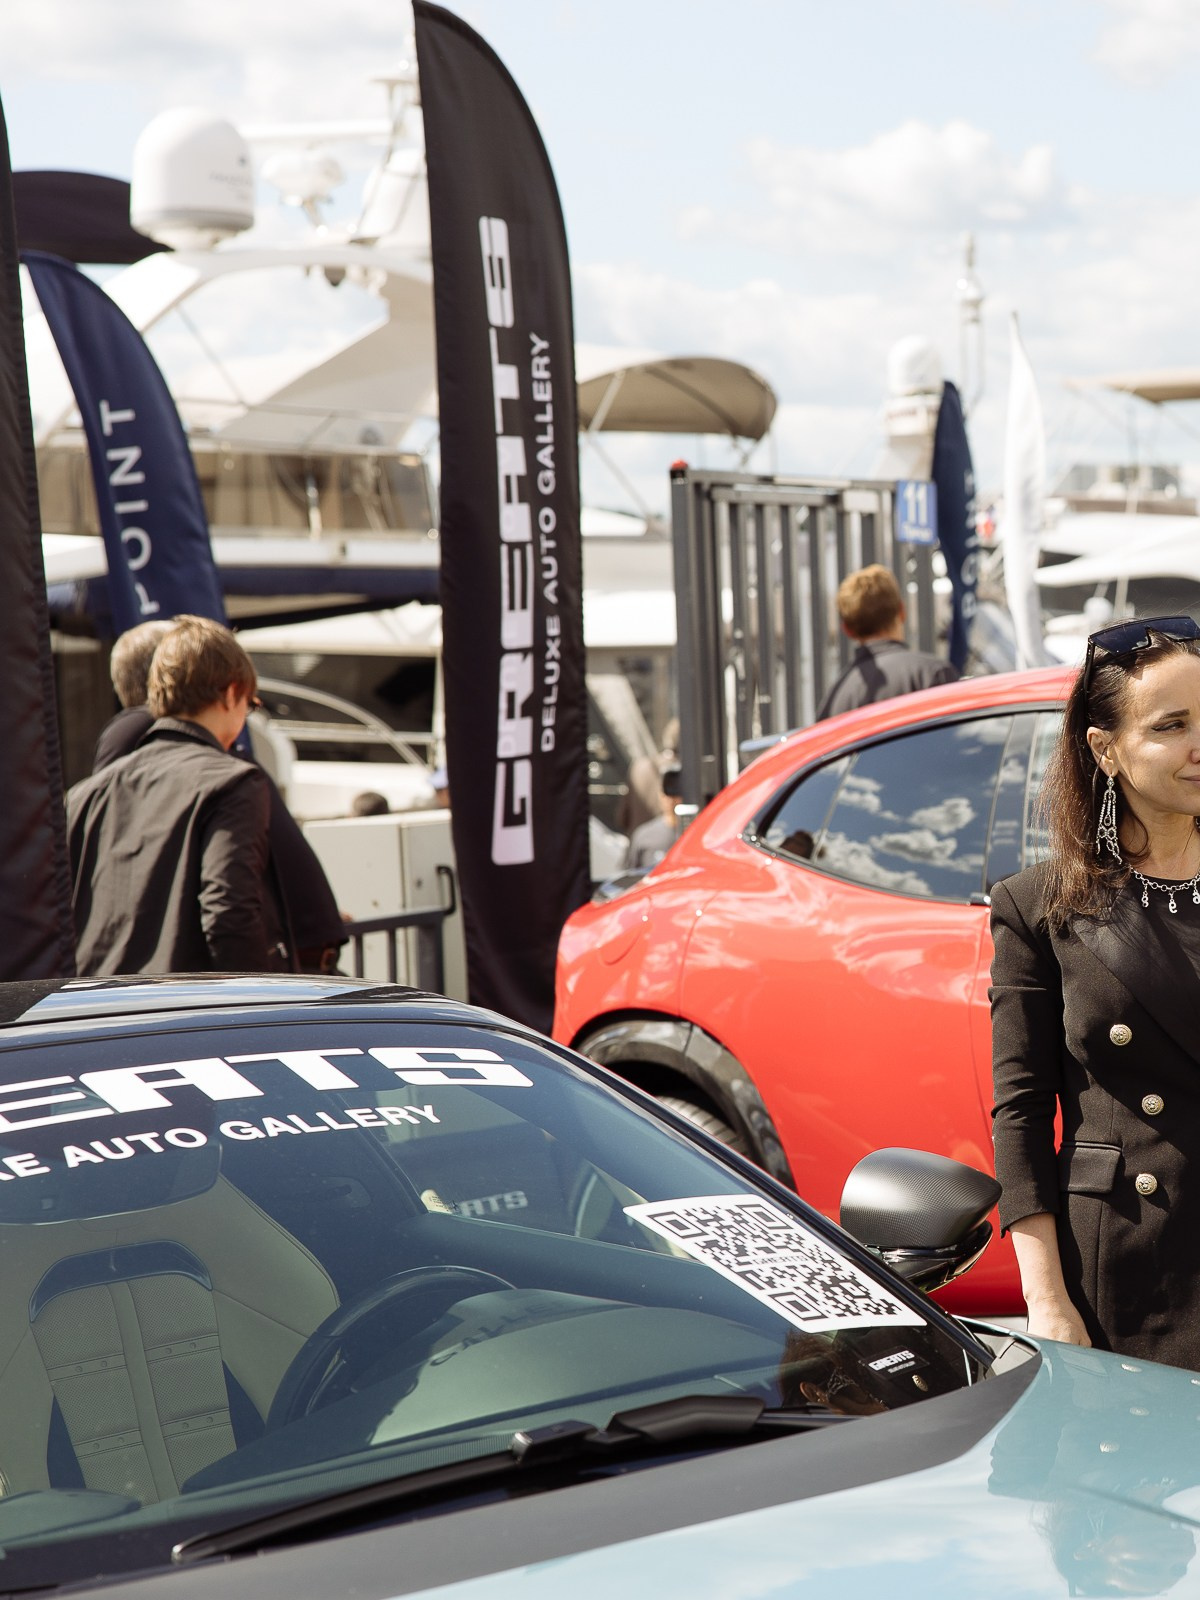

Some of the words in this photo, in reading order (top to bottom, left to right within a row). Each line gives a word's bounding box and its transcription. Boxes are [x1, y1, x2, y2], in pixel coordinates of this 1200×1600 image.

[529, 332, 556, 495] GALLERY
[479, 216, 534, 865] GREATS
[539, 506, 559, 604] AUTO
[540, 614, 561, 752] DELUXE
[62, 1127, 208, 1168] AUTO
[219, 1104, 441, 1140] GALLERY
[456, 1190, 528, 1217] ATS
